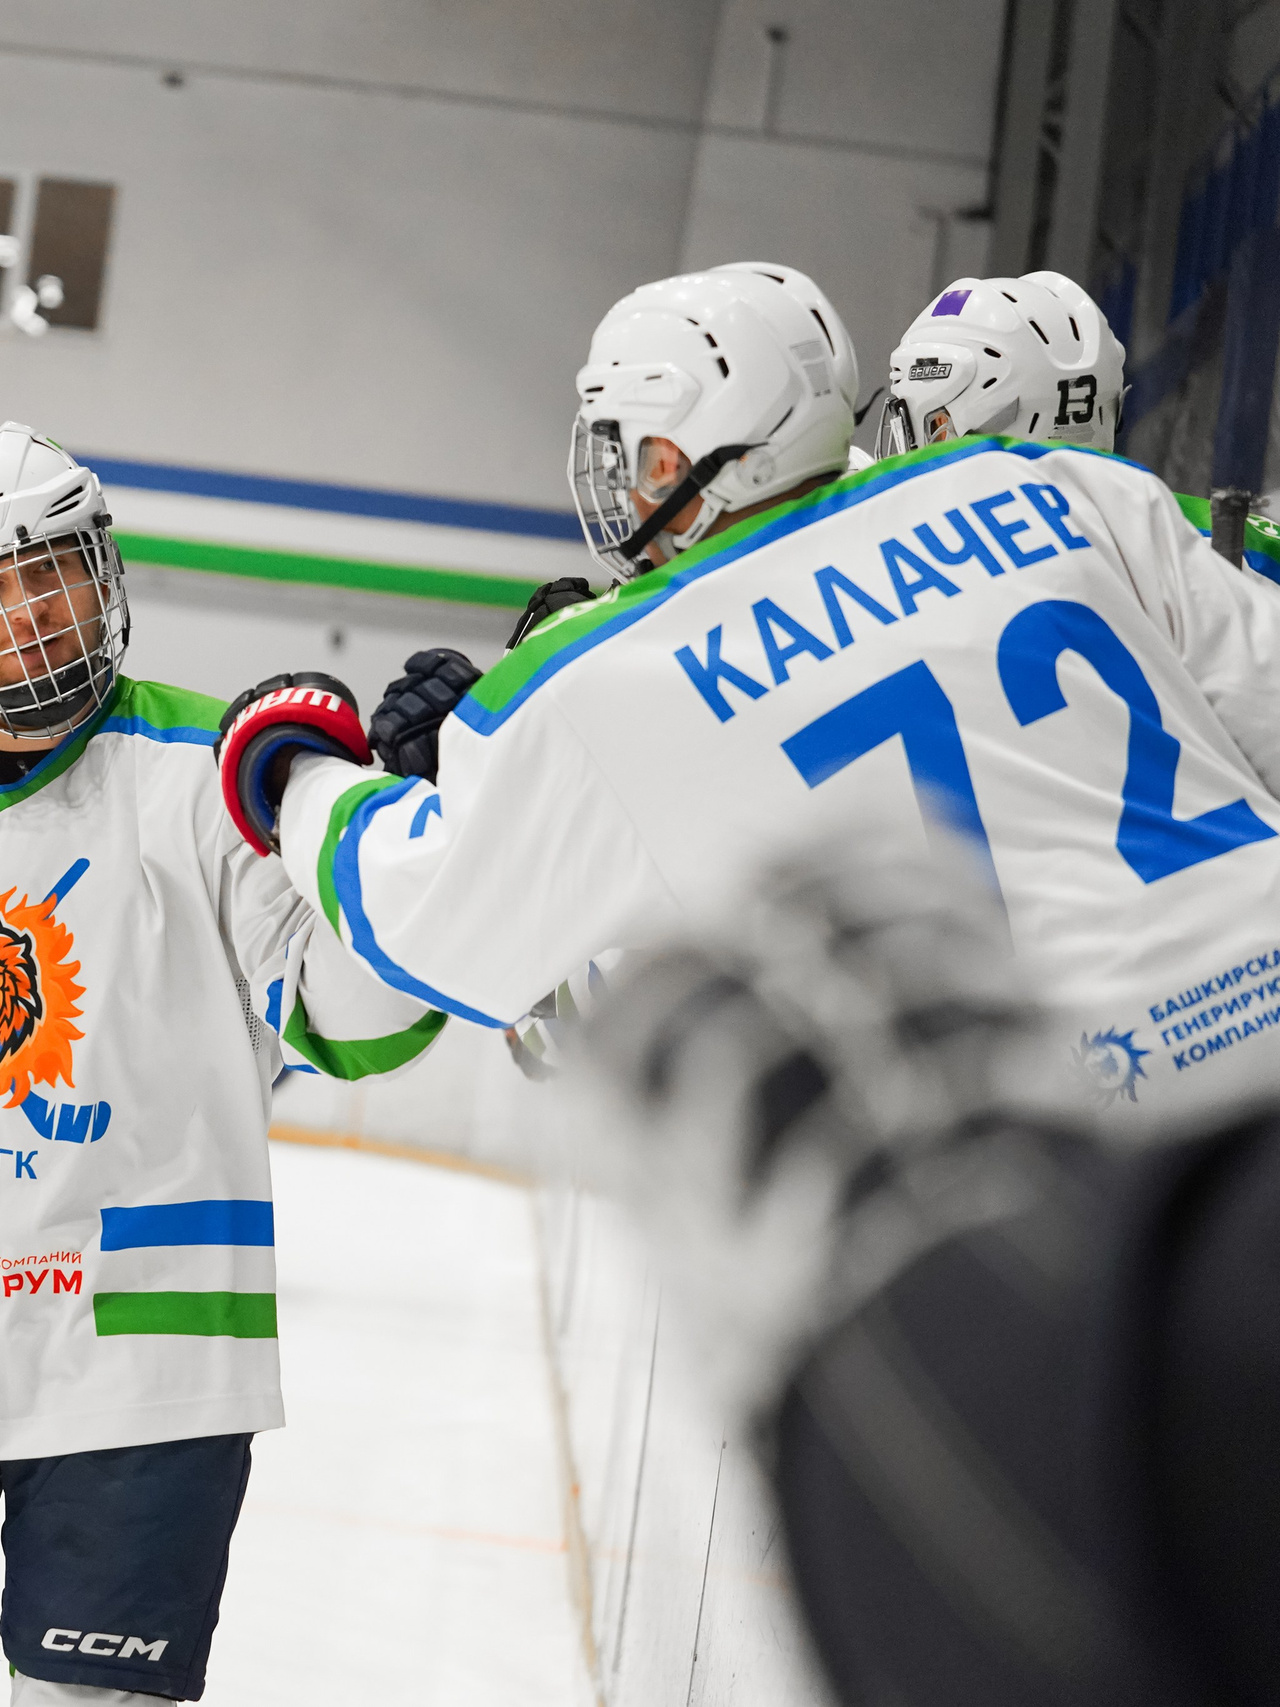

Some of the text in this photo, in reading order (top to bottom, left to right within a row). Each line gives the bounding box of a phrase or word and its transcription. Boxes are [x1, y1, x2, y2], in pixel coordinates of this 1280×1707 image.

[1054, 374, 1097, 426] 13
[674, 483, 1092, 724] КАЛАЧЕВ
[780, 598, 1280, 920] 72
[41, 1628, 169, 1661] CCM
